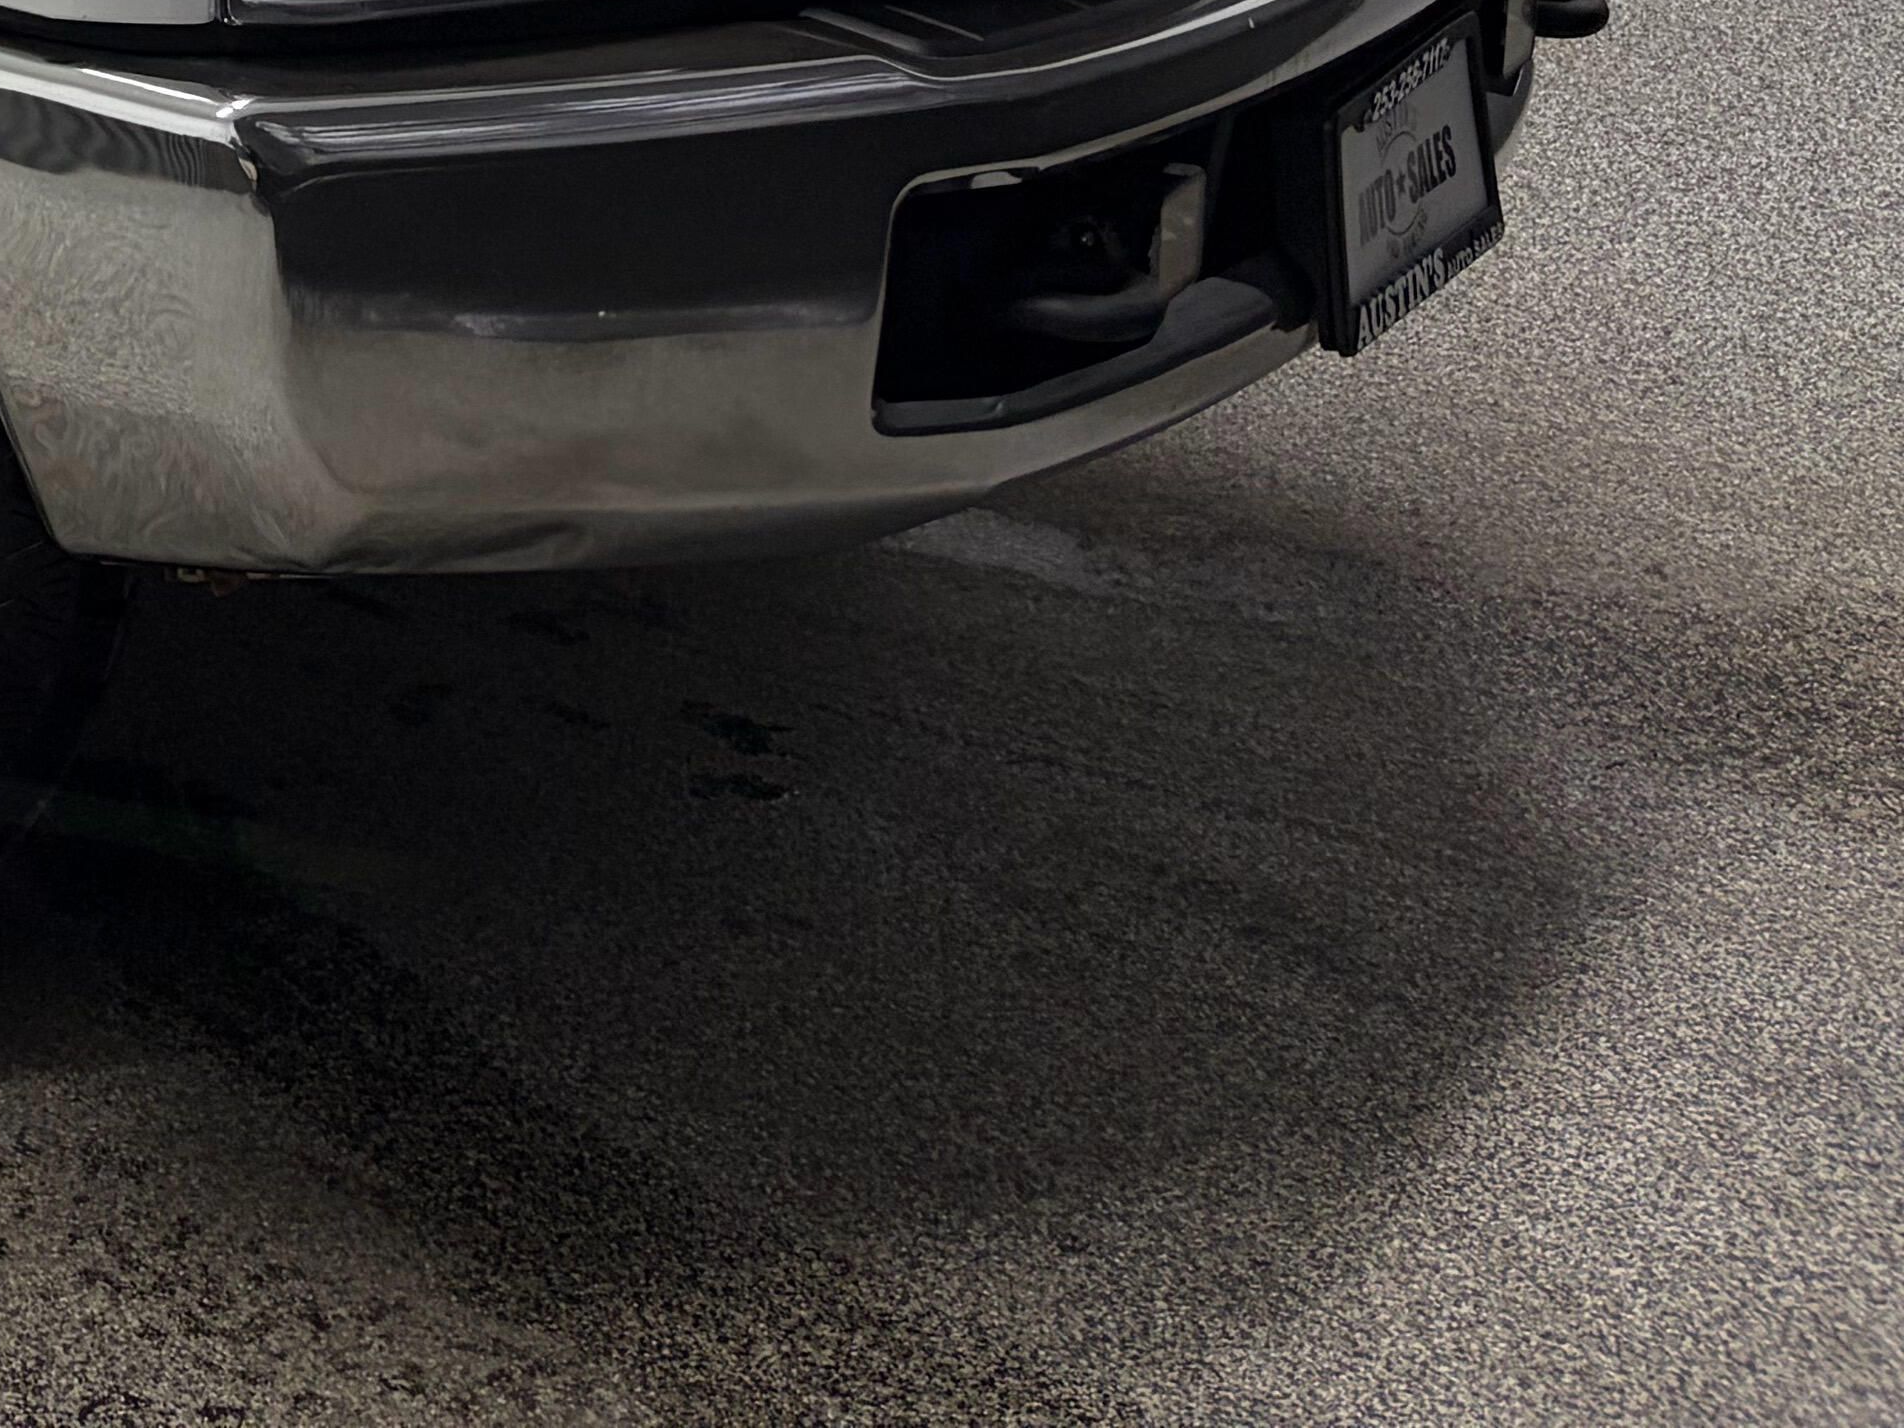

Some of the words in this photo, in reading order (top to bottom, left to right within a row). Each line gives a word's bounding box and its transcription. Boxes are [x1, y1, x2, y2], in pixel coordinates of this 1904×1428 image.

[1358, 169, 1396, 247] AUTO
[1406, 124, 1457, 204] SALES
[1356, 246, 1446, 351] AUSTIN'S
